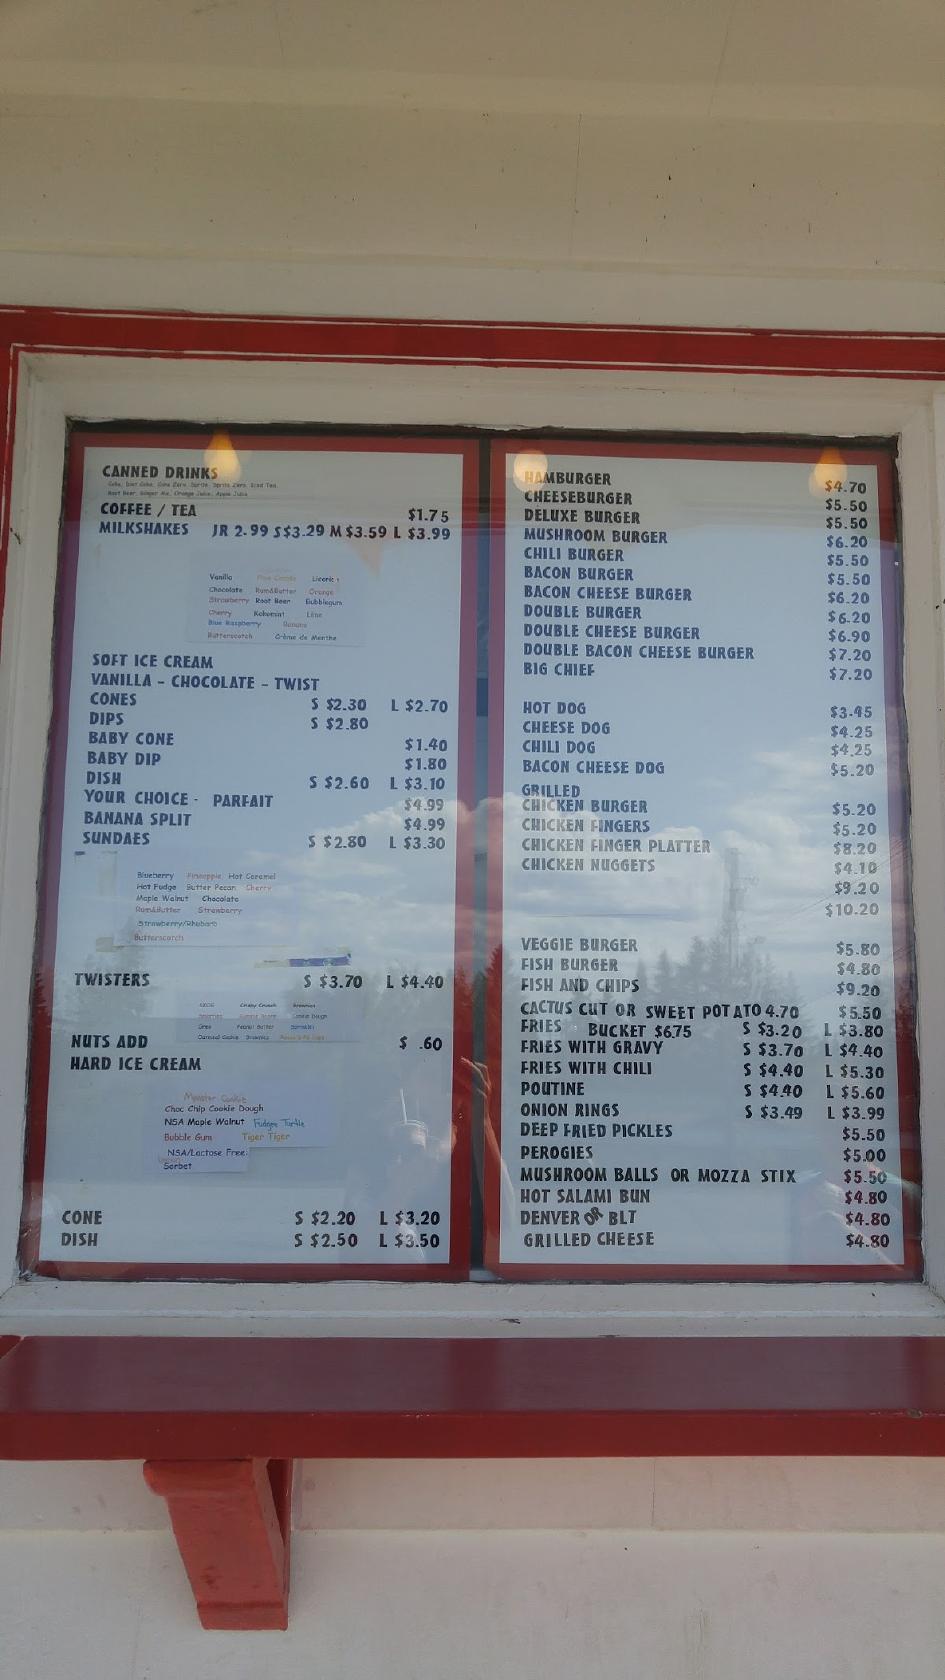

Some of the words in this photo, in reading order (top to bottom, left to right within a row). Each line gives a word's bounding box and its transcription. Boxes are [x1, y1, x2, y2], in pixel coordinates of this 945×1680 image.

[102, 465, 158, 478] CANNED
[166, 466, 218, 480] DRINKS
[525, 472, 611, 486] HAMBURGER
[525, 490, 632, 505] CHEESEBURGER
[825, 498, 867, 512] $5.50
[101, 503, 152, 516] COFFEE
[172, 504, 197, 517] TEA
[409, 508, 449, 523] $1.75
[525, 508, 578, 522] DELUXE
[584, 510, 640, 524] BURGER
[99, 521, 188, 535] MILKSHAKES
[235, 524, 268, 537] 2.99
[408, 527, 450, 540] $3.99
[524, 528, 605, 542] MUSHROOM
[612, 530, 668, 544] BURGER
[827, 535, 868, 548] $6.20
[524, 547, 561, 560] CHILI
[568, 548, 624, 562] BURGER
[524, 585, 571, 599] BACON
[577, 587, 629, 600] CHEESE
[636, 588, 692, 601] BURGER
[524, 643, 579, 656] DOUBLE
[586, 644, 632, 658] BACON
[639, 646, 691, 659] CHEESE
[698, 647, 754, 659] BURGER
[93, 654, 128, 666] SOFT
[135, 654, 157, 667] ICE
[164, 655, 213, 669] CREAM
[524, 662, 547, 675] BIG
[555, 663, 595, 676] CHIEF
[830, 667, 872, 681] $7.20
[91, 673, 152, 687] VANILLA
[172, 675, 255, 689] CHOCOLATE
[275, 677, 320, 691] TWIST
[90, 692, 137, 706] CONES
[327, 697, 367, 711] $2.30
[406, 699, 448, 713] $2.70
[523, 701, 551, 714] HOT
[557, 702, 586, 715] DOG
[90, 712, 124, 726] DIPS
[523, 721, 574, 734] CHEESE
[581, 722, 610, 735] DOG
[89, 732, 129, 744] BABY
[136, 732, 174, 746] CONE
[405, 738, 447, 752] $1.40
[523, 760, 569, 773] BACON
[576, 761, 629, 774] CHEESE
[636, 762, 664, 774] DOG
[87, 771, 121, 785] DISH
[84, 789, 125, 804] YOUR
[135, 792, 188, 806] CHOICE
[214, 794, 274, 807] PARFAIT
[522, 784, 580, 798] GRILLED
[523, 799, 584, 812] CHICKEN
[591, 800, 648, 813] BURGER
[84, 811, 143, 825] BANANA
[151, 813, 192, 826] SPLIT
[404, 817, 445, 831] $4.99
[83, 832, 150, 845] SUNDAES
[324, 835, 366, 849] $2.80
[404, 836, 445, 850] $3.30
[522, 838, 584, 852] CHICKEN
[591, 839, 642, 852] FINGER
[649, 840, 710, 853] PLATTER
[522, 858, 584, 871] CHICKEN
[591, 859, 655, 872] NUGGETS
[138, 872, 174, 881] Blueberry
[154, 884, 177, 892] Fudge
[136, 895, 158, 903] Maple
[825, 903, 879, 918] $10.20
[521, 937, 573, 951] VEGGIE
[580, 938, 638, 952] BURGER
[836, 941, 880, 956] $5.80
[75, 973, 150, 987] TWISTERS
[320, 974, 363, 989] $3.70
[401, 974, 444, 989] $4.40
[521, 978, 553, 992] FISH
[560, 978, 589, 992] AND
[596, 979, 640, 993] CHIPS
[521, 1000, 573, 1015] CACTUS
[579, 1003, 608, 1016] CUT
[646, 1005, 695, 1020] SWEET
[521, 1019, 561, 1033] FRIES
[588, 1023, 646, 1037] BUCKET
[655, 1025, 692, 1039] $6.75
[840, 1023, 884, 1038] $3.80
[71, 1035, 110, 1048] NUTS
[116, 1035, 148, 1048] ADD
[521, 1040, 562, 1054] FRIES
[568, 1040, 606, 1054] WITH
[613, 1041, 664, 1055] GRAVY
[71, 1057, 111, 1070] HARD
[119, 1057, 143, 1070] ICE
[150, 1058, 201, 1071] CREAM
[521, 1082, 584, 1096] POUTINE
[760, 1084, 803, 1098] $4.40
[841, 1085, 884, 1100] $5.60
[165, 1105, 184, 1113] Choc
[188, 1105, 206, 1114] Chip
[209, 1104, 235, 1112] Cookie
[239, 1104, 264, 1114] Dough
[521, 1103, 568, 1117] ONION
[575, 1103, 619, 1117] RINGS
[165, 1118, 184, 1126] NSA
[188, 1118, 212, 1127] Maple
[521, 1122, 558, 1137] DEEP
[564, 1123, 606, 1138] FRIED
[613, 1123, 673, 1138] PICKLES
[164, 1133, 191, 1141] Bubble
[195, 1133, 212, 1141] Gum
[241, 1132, 264, 1143] Tiger
[268, 1132, 290, 1142] Tiger
[521, 1146, 593, 1159] PEROGIES
[843, 1147, 886, 1163] $5.00
[164, 1162, 192, 1170] Sorbet
[520, 1167, 607, 1182] MUSHROOM
[614, 1168, 658, 1182] BALLS
[698, 1169, 750, 1183] MOZZA
[761, 1170, 796, 1183] STIX
[521, 1189, 551, 1203] HOT
[557, 1189, 611, 1203] SALAMI
[620, 1189, 650, 1203] BUN
[62, 1210, 102, 1225] CONE
[312, 1210, 356, 1226] $2.20
[395, 1211, 440, 1226] $3.20
[520, 1211, 580, 1225] DENVER
[609, 1210, 637, 1226] BLT
[846, 1211, 890, 1226] $4.80
[61, 1232, 98, 1246] DISH
